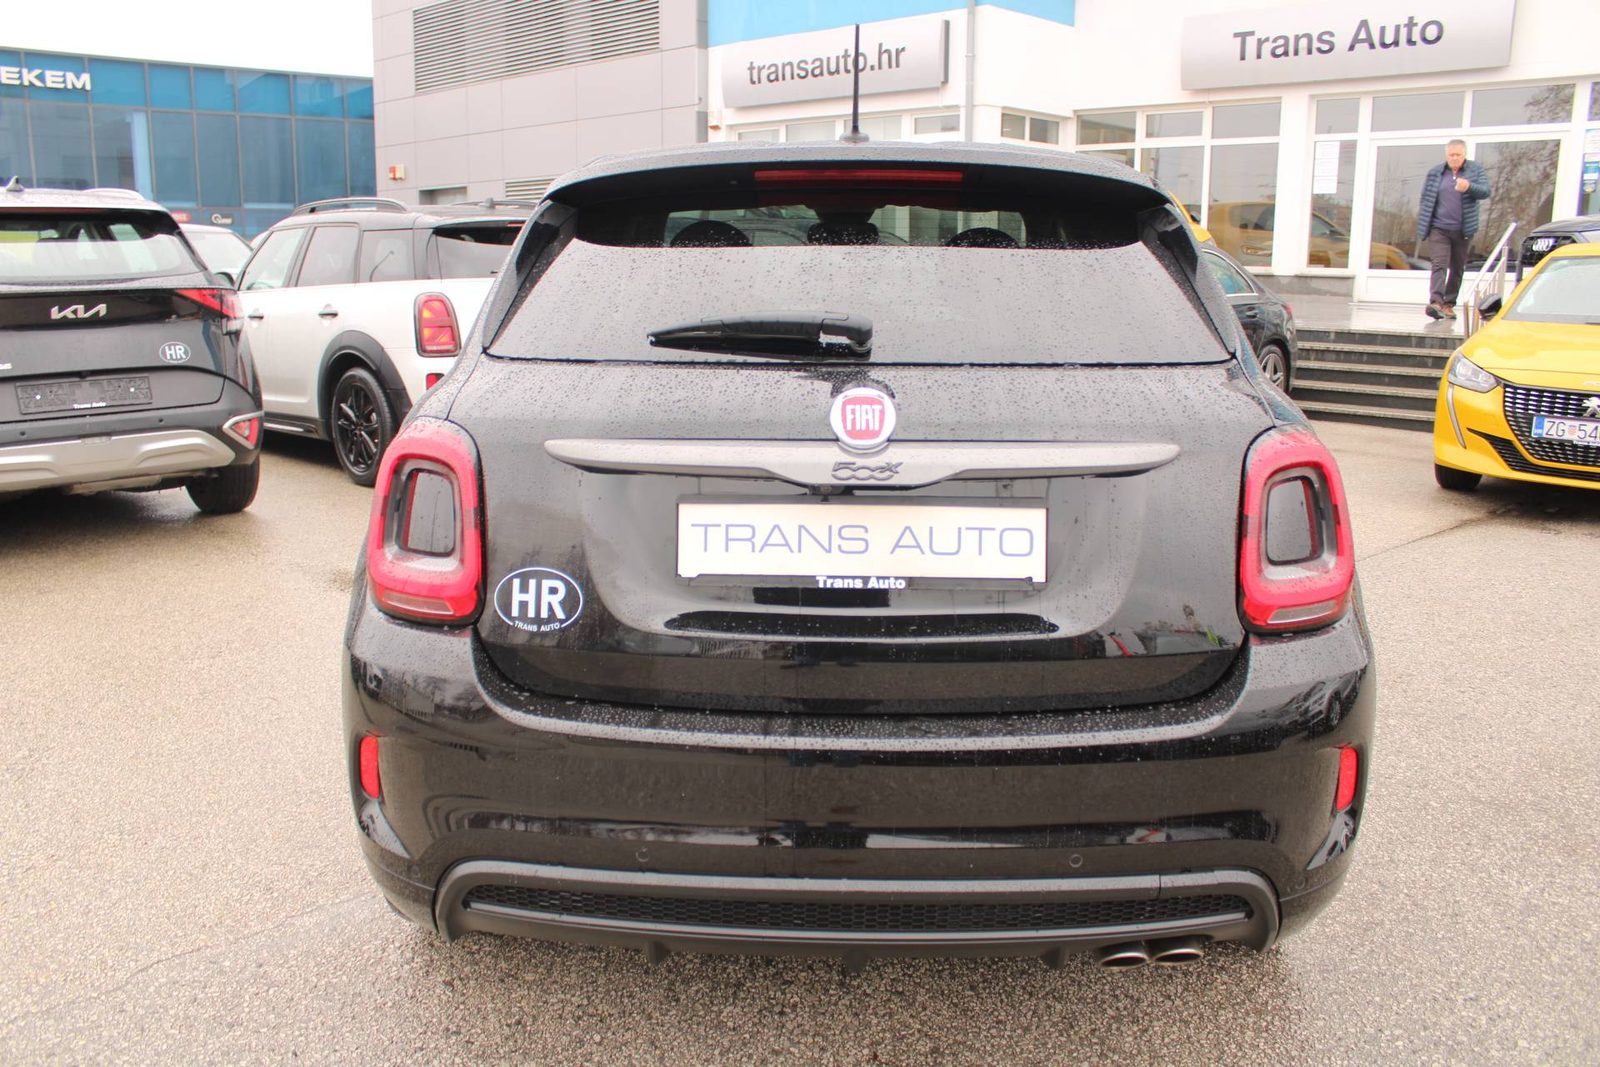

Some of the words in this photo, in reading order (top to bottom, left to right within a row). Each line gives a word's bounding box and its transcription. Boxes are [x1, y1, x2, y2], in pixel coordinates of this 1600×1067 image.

[1232, 29, 1336, 62] Trans
[1347, 15, 1445, 52] Auto
[747, 43, 906, 86] transauto.hr
[50, 303, 107, 320] KIA
[164, 345, 187, 360] HR
[845, 404, 883, 431] FIAT
[1545, 420, 1567, 438] ZG
[1577, 423, 1600, 441] 54
[690, 523, 870, 555] TRANS
[889, 525, 1035, 558] AUTO
[815, 576, 864, 589] Trans
[866, 576, 906, 589] Auto
[511, 577, 567, 620] HR
[513, 620, 538, 632] TRANS
[539, 622, 561, 633] AUTO
